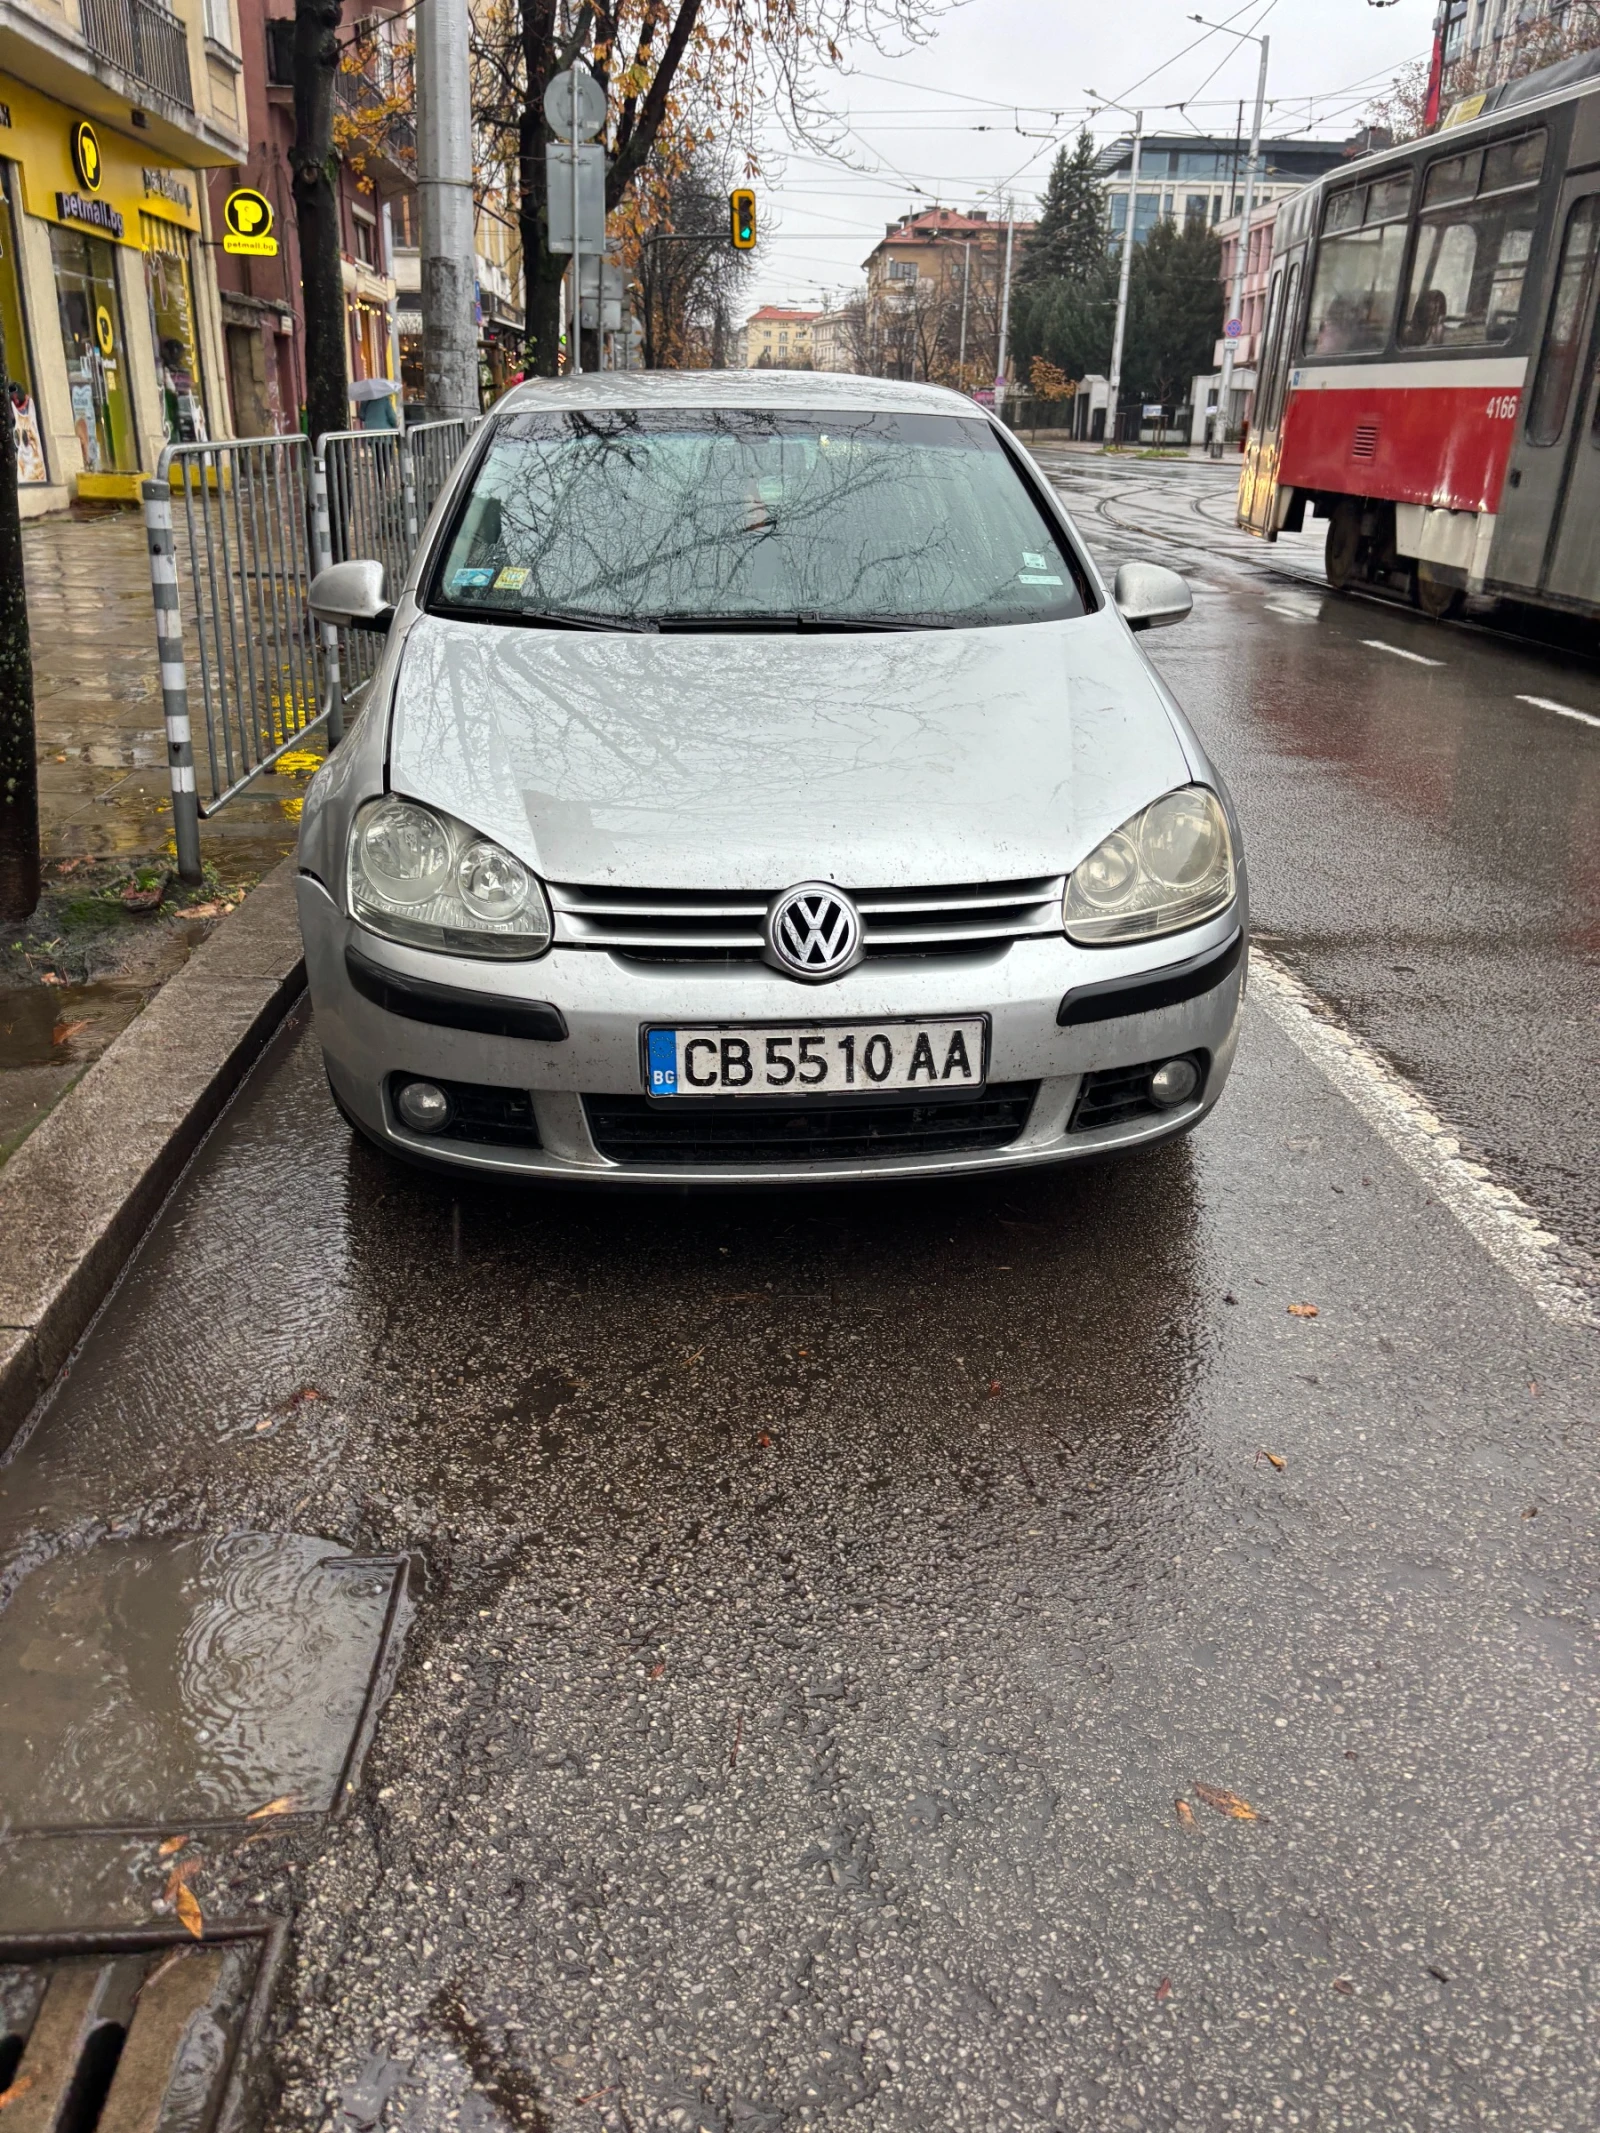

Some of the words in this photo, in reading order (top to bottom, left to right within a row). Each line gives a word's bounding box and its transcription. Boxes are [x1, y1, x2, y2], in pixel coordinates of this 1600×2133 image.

[58, 192, 125, 238] petmall.bg
[226, 241, 275, 252] petmall.bg
[1486, 395, 1518, 419] 4166
[774, 889, 853, 970] VW
[653, 1070, 675, 1086] BG
